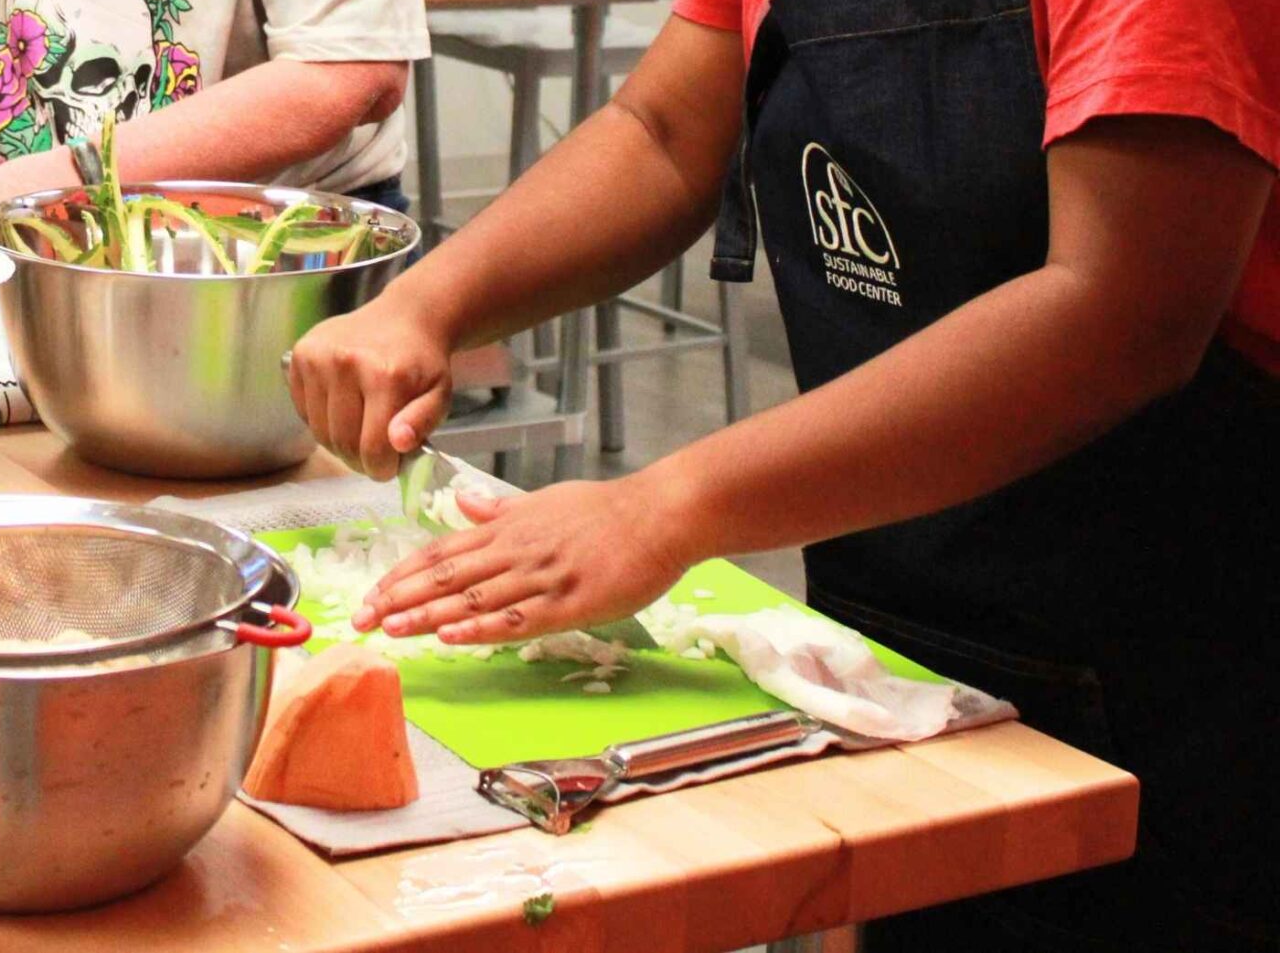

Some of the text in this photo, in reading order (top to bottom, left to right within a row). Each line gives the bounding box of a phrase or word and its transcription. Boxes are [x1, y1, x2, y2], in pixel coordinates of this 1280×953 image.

[814, 161, 891, 265] sfc
[822, 251, 898, 286] SUSTAINABLE
[825, 270, 903, 307] FOOD CENTER
